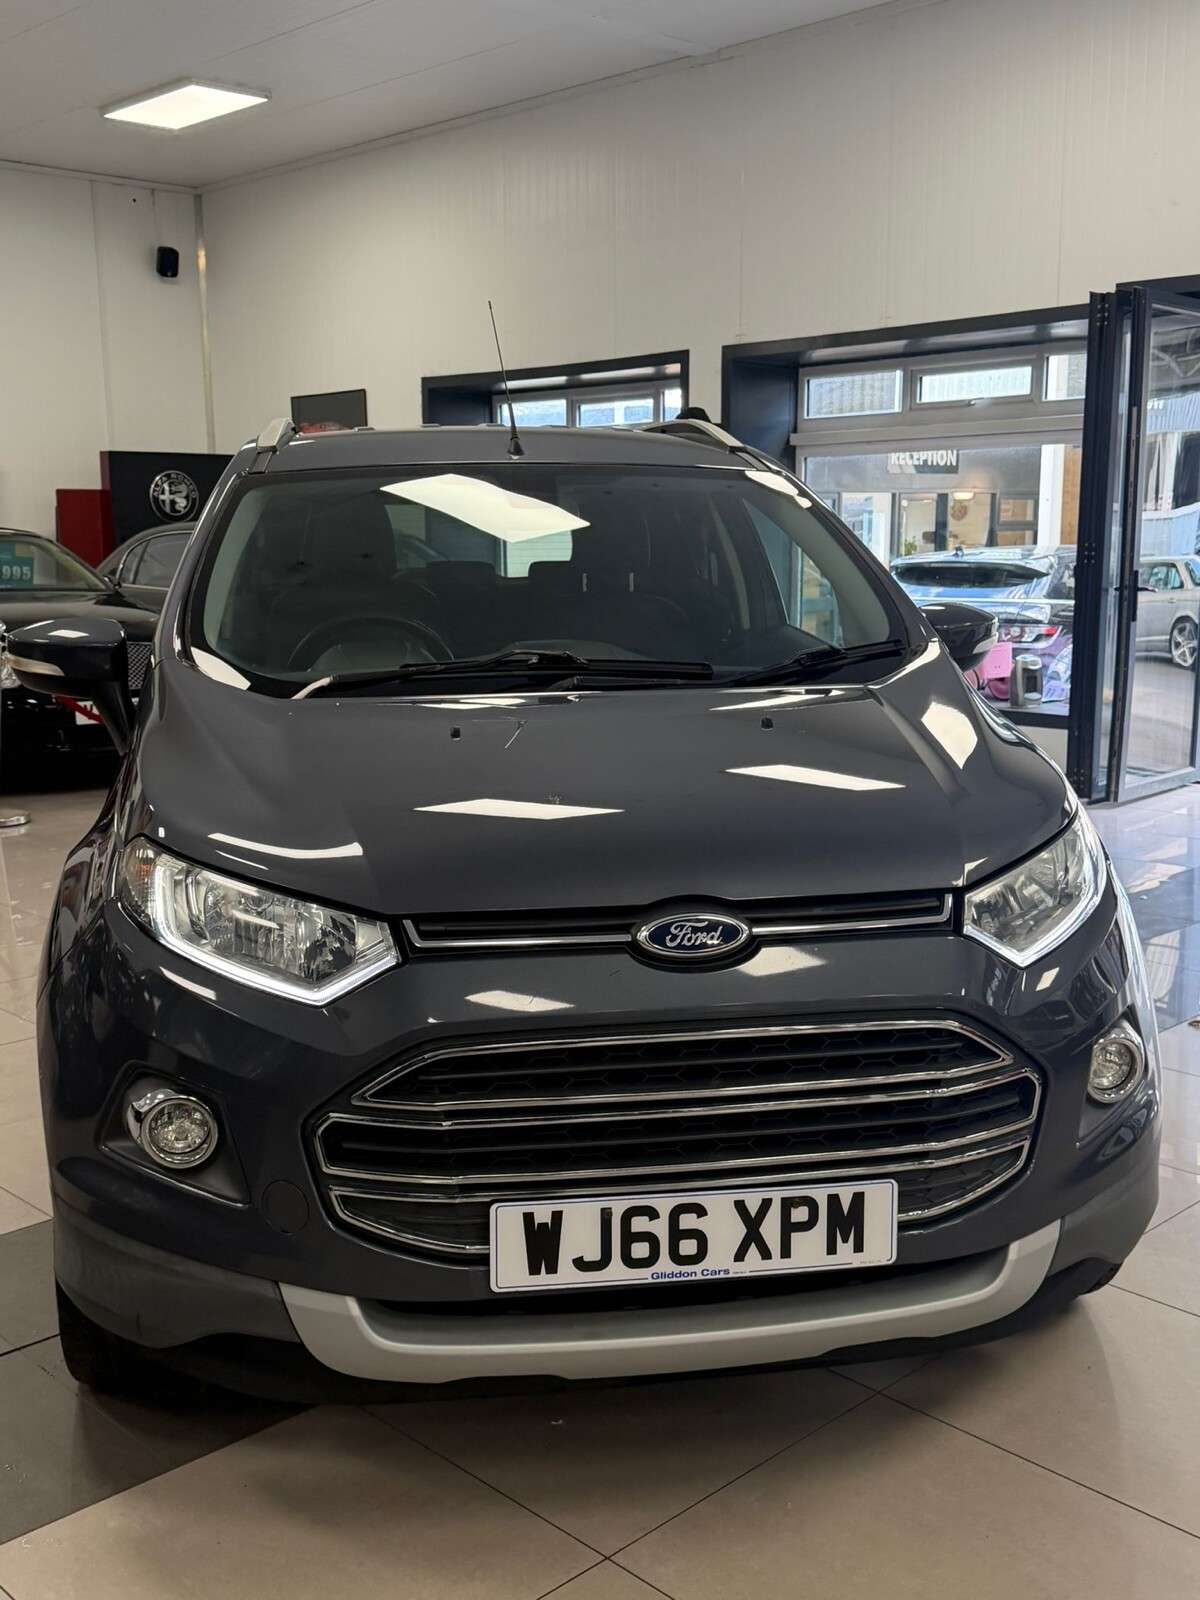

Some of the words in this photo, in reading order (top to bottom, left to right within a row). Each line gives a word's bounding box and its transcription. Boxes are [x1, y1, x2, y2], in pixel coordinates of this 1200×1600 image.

[891, 449, 957, 466] RECEPTION
[665, 921, 723, 947] Ford
[522, 1202, 708, 1276] WJ66
[733, 1191, 865, 1263] XPM
[651, 1270, 697, 1280] Gliddon
[701, 1268, 730, 1277] Cars
